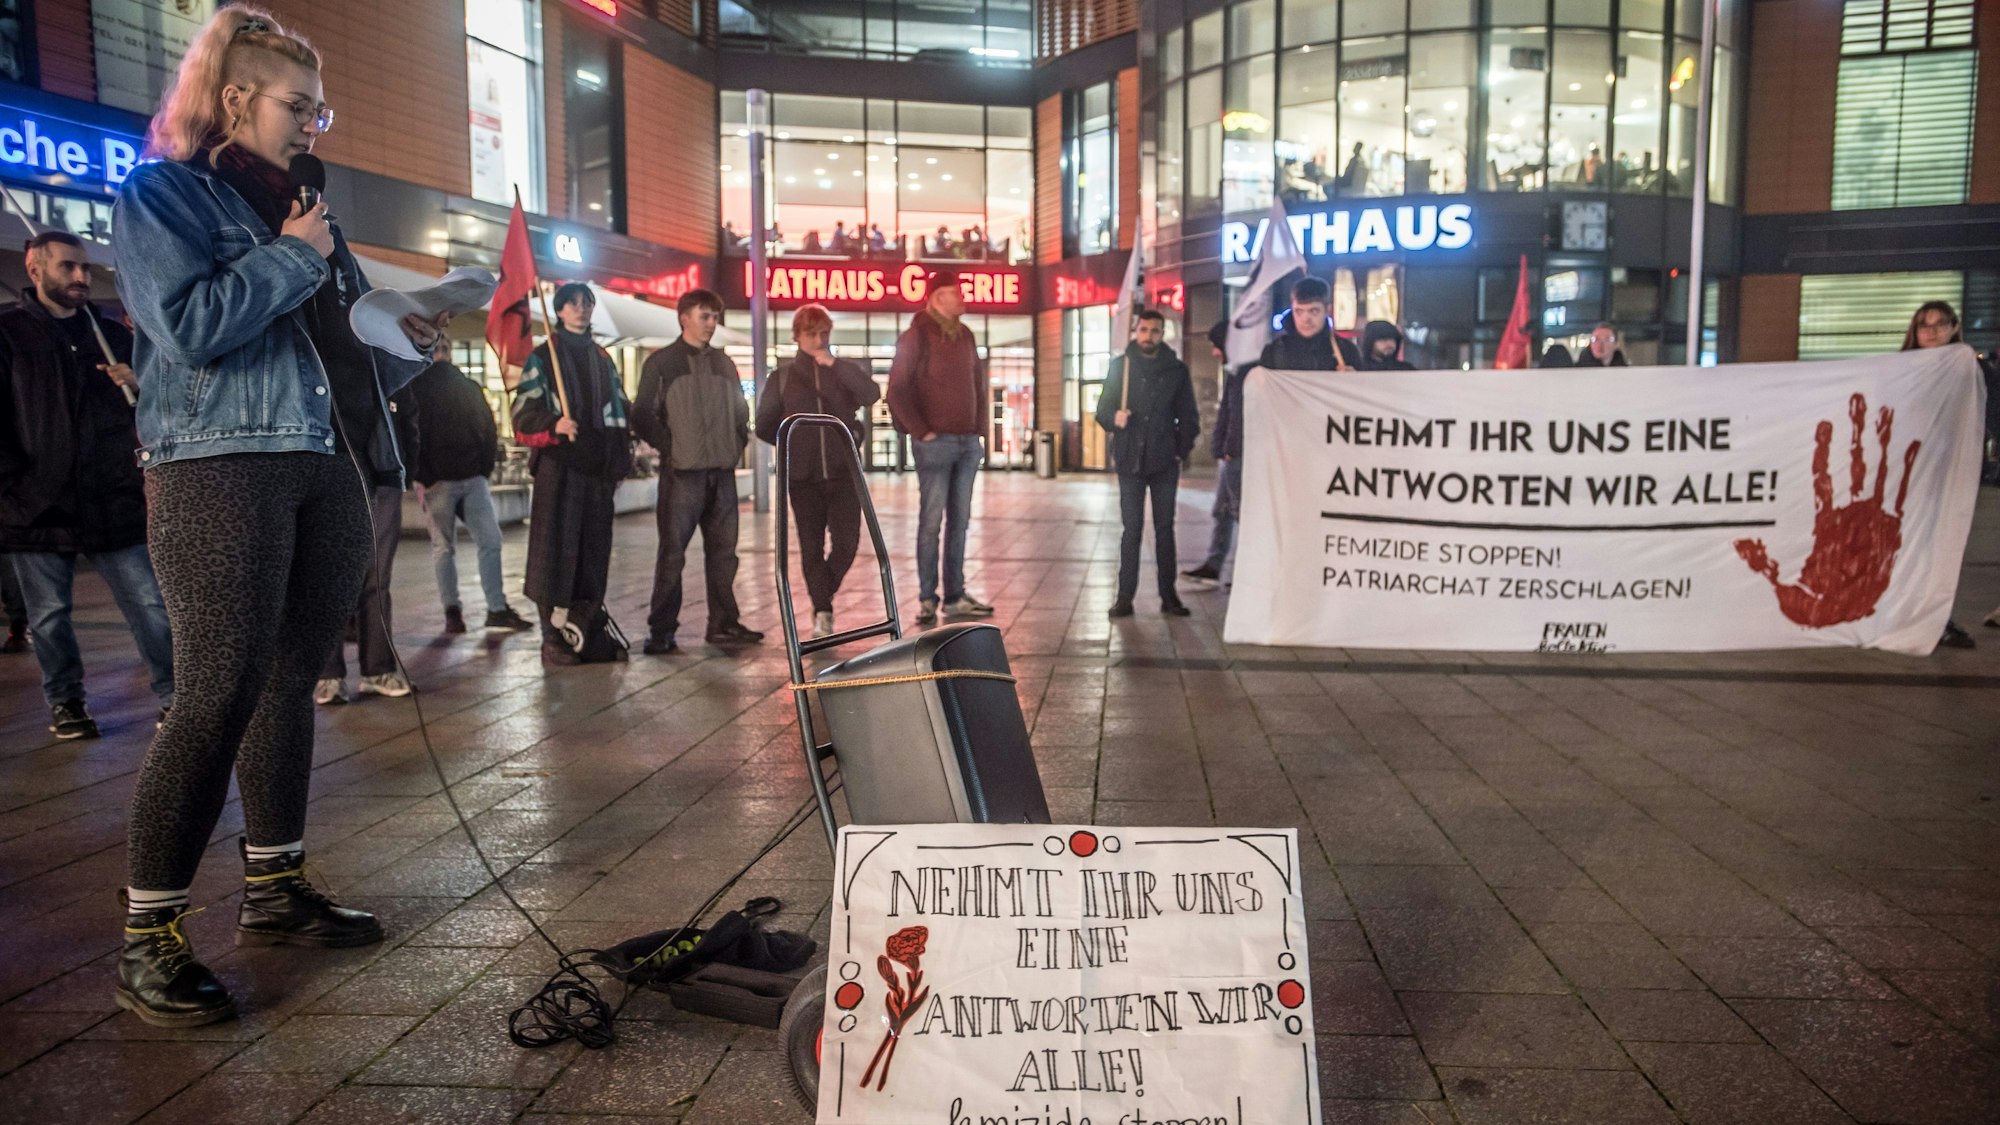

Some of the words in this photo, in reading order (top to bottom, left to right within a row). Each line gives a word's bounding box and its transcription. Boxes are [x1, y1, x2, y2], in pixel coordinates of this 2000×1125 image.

[1326, 415, 1457, 449] NEHMT
[1470, 421, 1533, 452] IHR
[1548, 420, 1631, 454] UNS
[1645, 418, 1731, 452] EINE
[1326, 466, 1572, 507] ANTWORTEN
[1586, 475, 1658, 507] WIR
[1671, 470, 1778, 505] ALLE!
[1325, 535, 1429, 563] FEMIZIDE
[1439, 543, 1562, 568] STOPPEN!
[1323, 566, 1490, 597] PATRIARCHAT
[1499, 577, 1692, 600] ZERSCHLAGEN!
[1542, 622, 1608, 639] FRAUEN
[887, 864, 1063, 919] NEHMT
[1079, 869, 1163, 921] IHR
[1174, 871, 1264, 915] UNS
[1016, 925, 1129, 970] EINE
[914, 993, 1183, 1038] ANTWORTEN
[1187, 982, 1281, 1026] WIR
[1005, 1048, 1145, 1098] ALLE!
